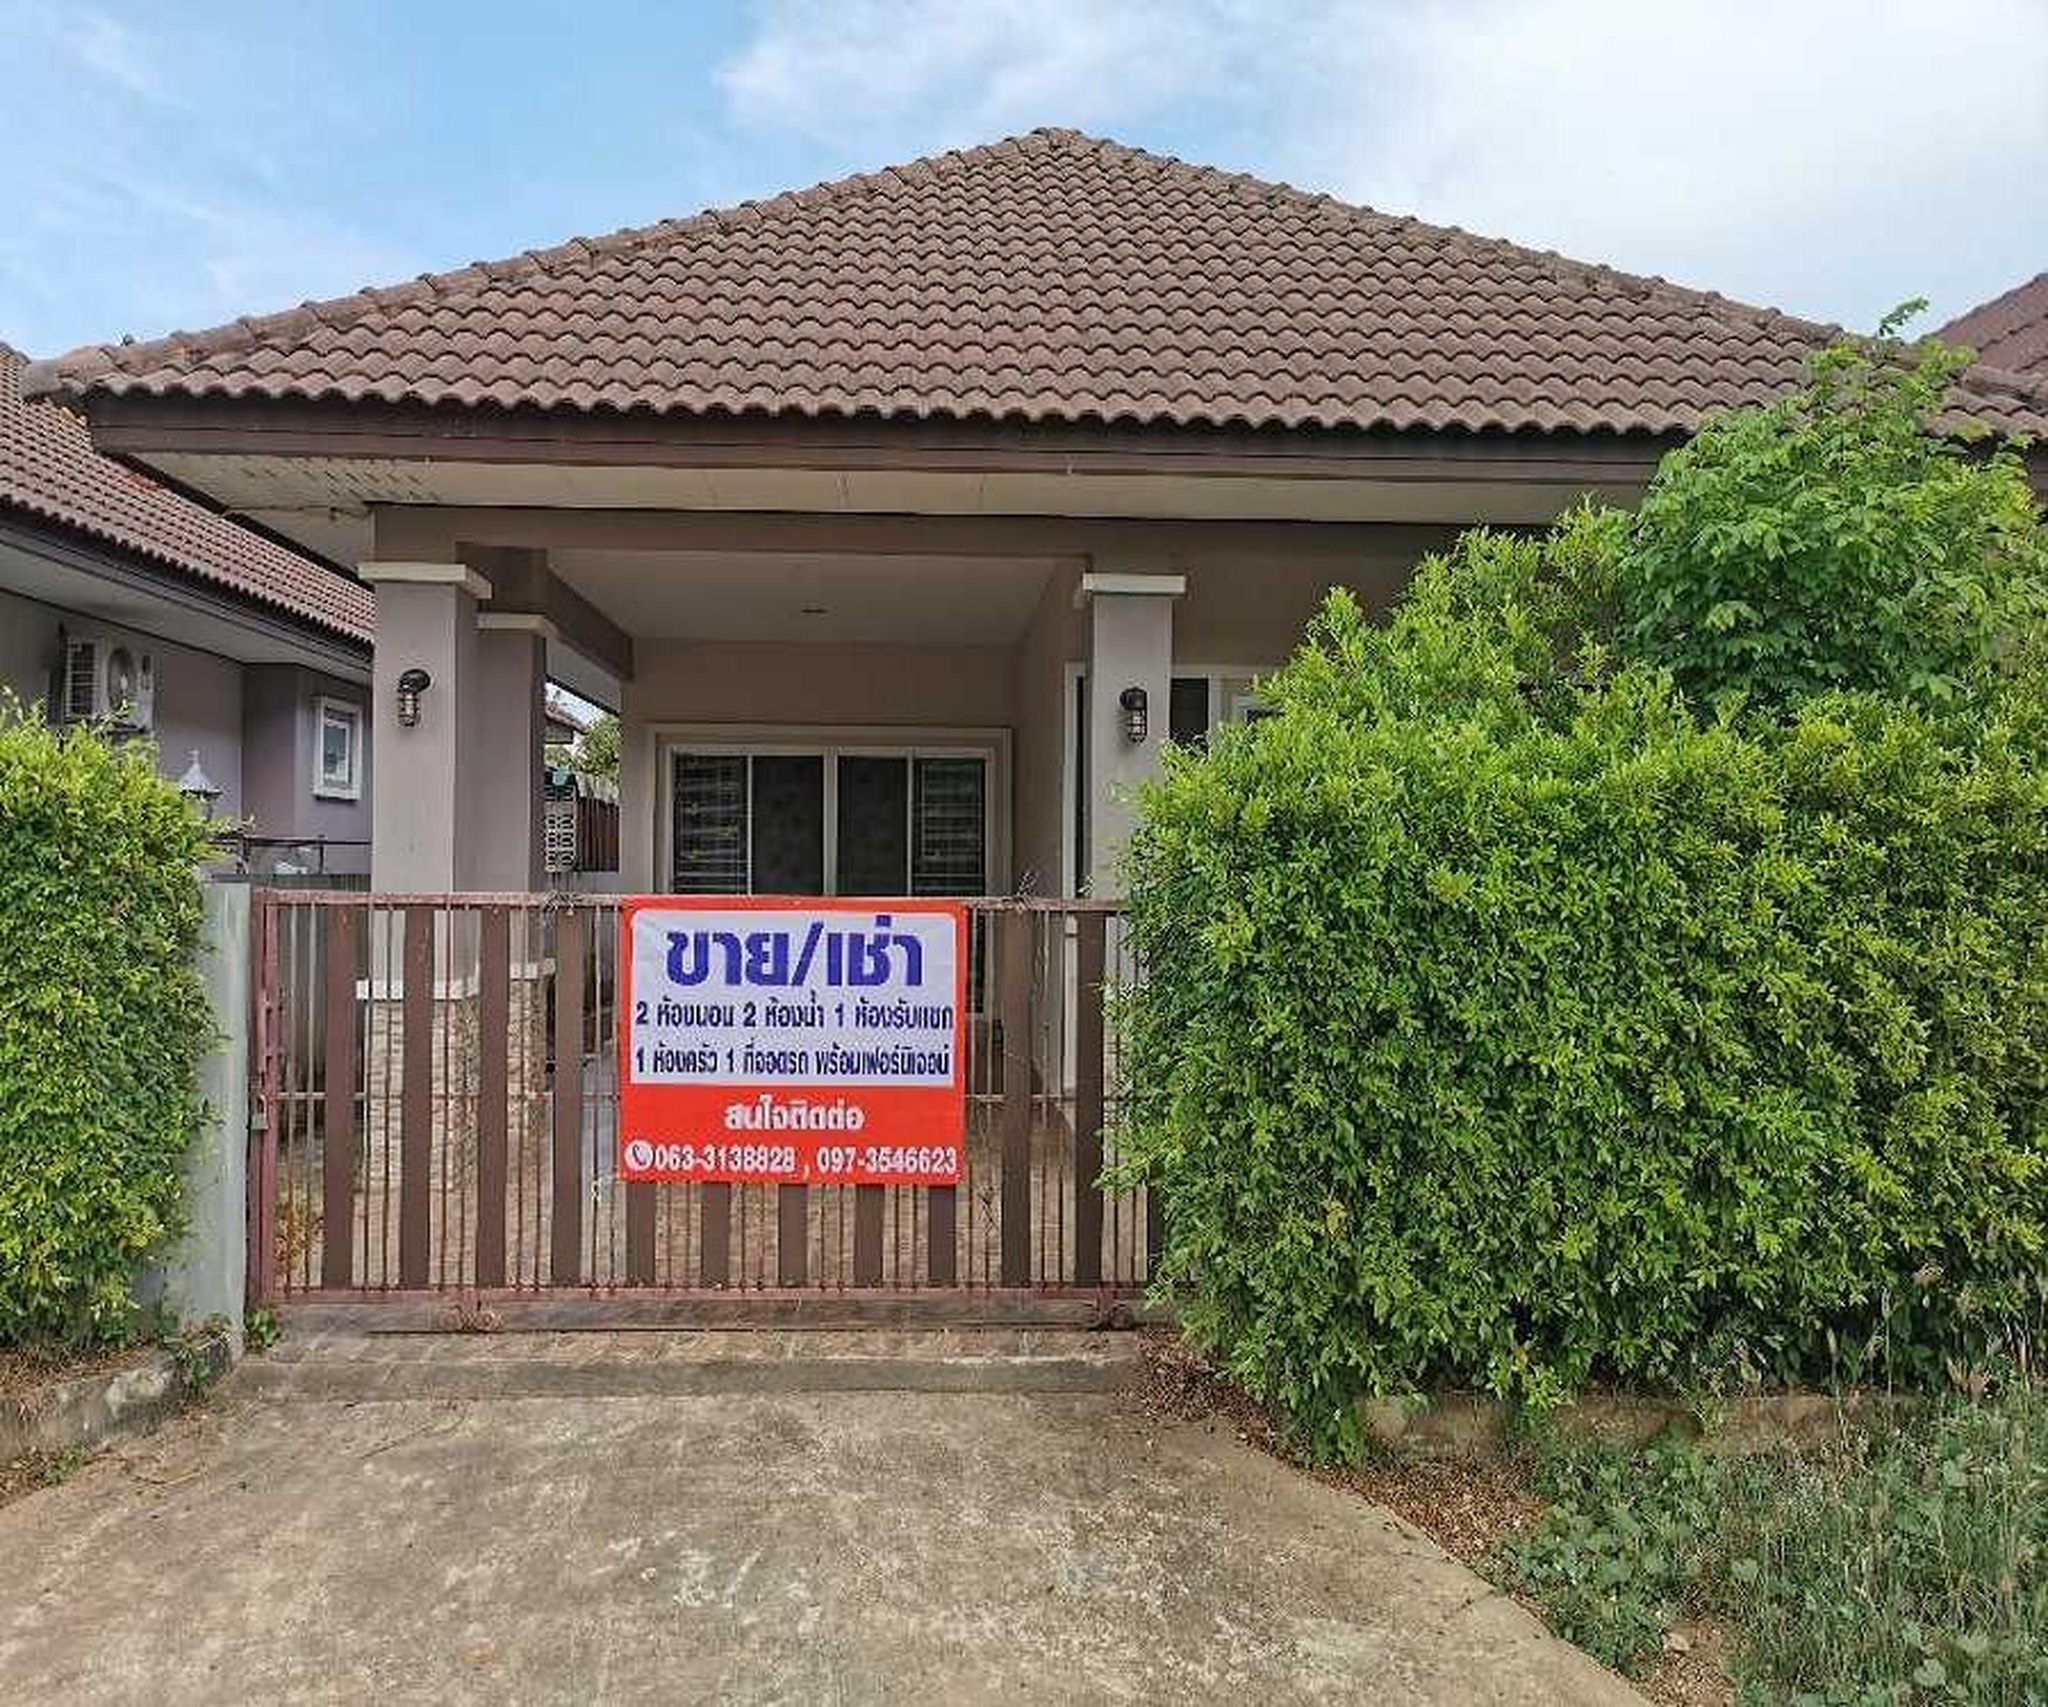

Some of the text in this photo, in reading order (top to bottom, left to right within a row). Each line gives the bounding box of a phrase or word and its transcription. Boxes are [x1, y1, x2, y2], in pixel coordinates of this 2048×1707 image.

[666, 914, 923, 987] ขาย/เช่า
[636, 1001, 649, 1025] 2
[656, 995, 734, 1028] ห้องนอน
[742, 1001, 757, 1028] 2
[834, 1003, 844, 1027] 1
[855, 996, 954, 1030] ห้องรับแขก
[636, 1047, 645, 1073] 1
[653, 1040, 718, 1073] ห้องครัว
[727, 1048, 735, 1073] 1
[725, 1093, 866, 1130] สนใจติดต่อ
